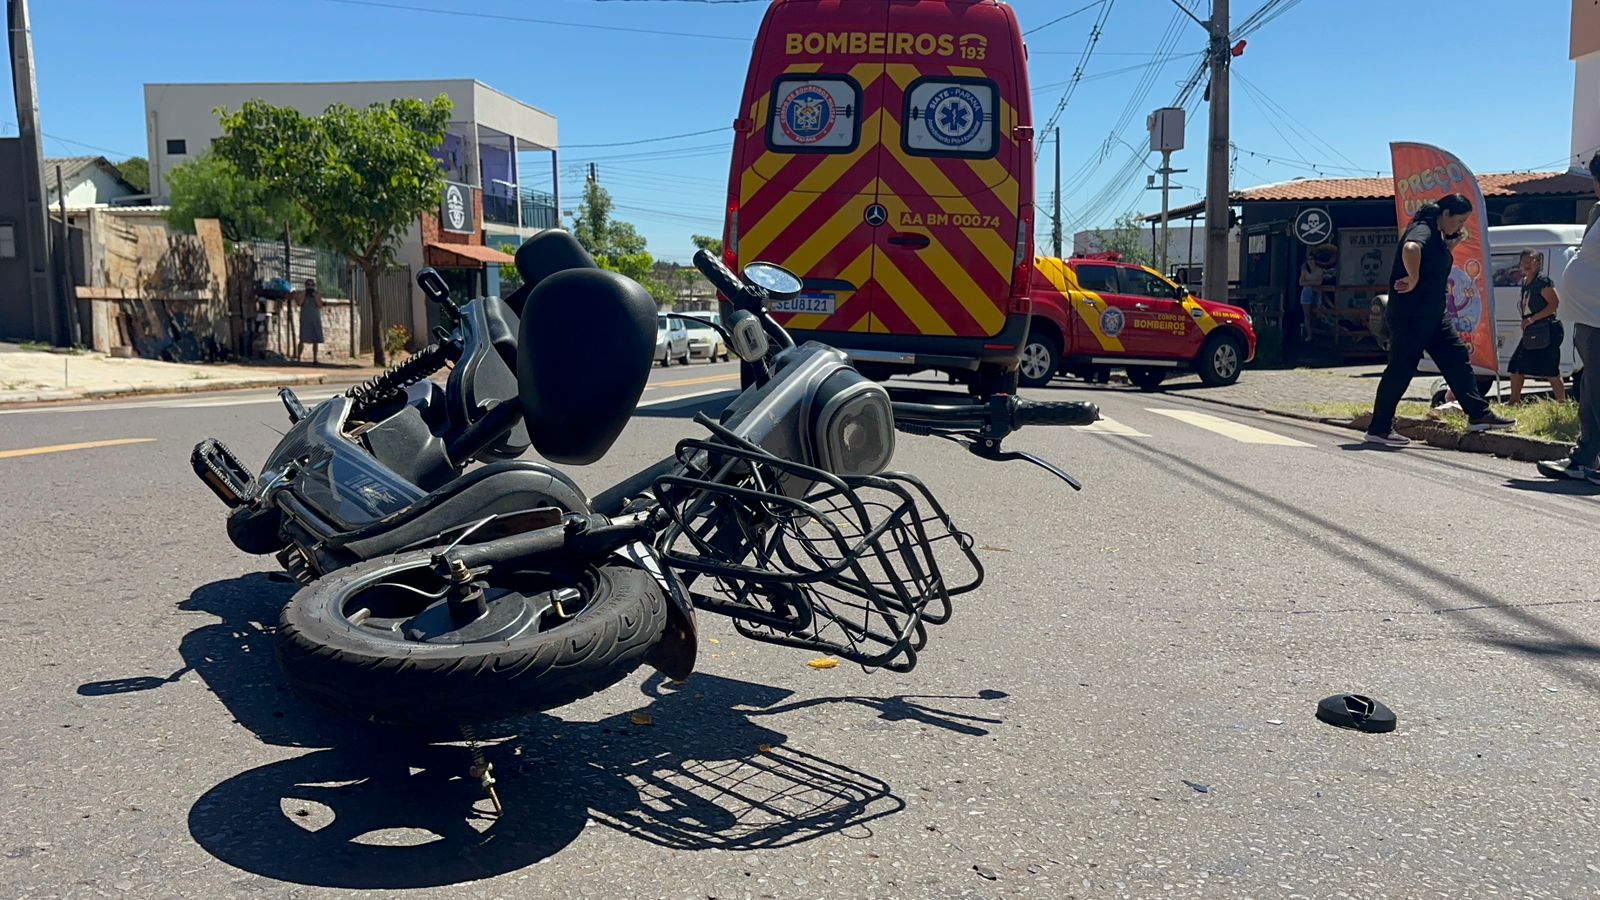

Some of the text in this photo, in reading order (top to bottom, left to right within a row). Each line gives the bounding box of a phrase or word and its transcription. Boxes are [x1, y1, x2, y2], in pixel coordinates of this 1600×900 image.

[786, 32, 954, 56] BOMBEIROS
[960, 46, 986, 60] 193
[930, 90, 950, 109] SIATE
[1397, 162, 1463, 199] PREÇO
[901, 213, 1000, 228] AA BM 00074
[1349, 234, 1399, 246] WANTED
[1158, 313, 1186, 322] CORPO DE
[1134, 320, 1185, 330] BOMBEIROS
